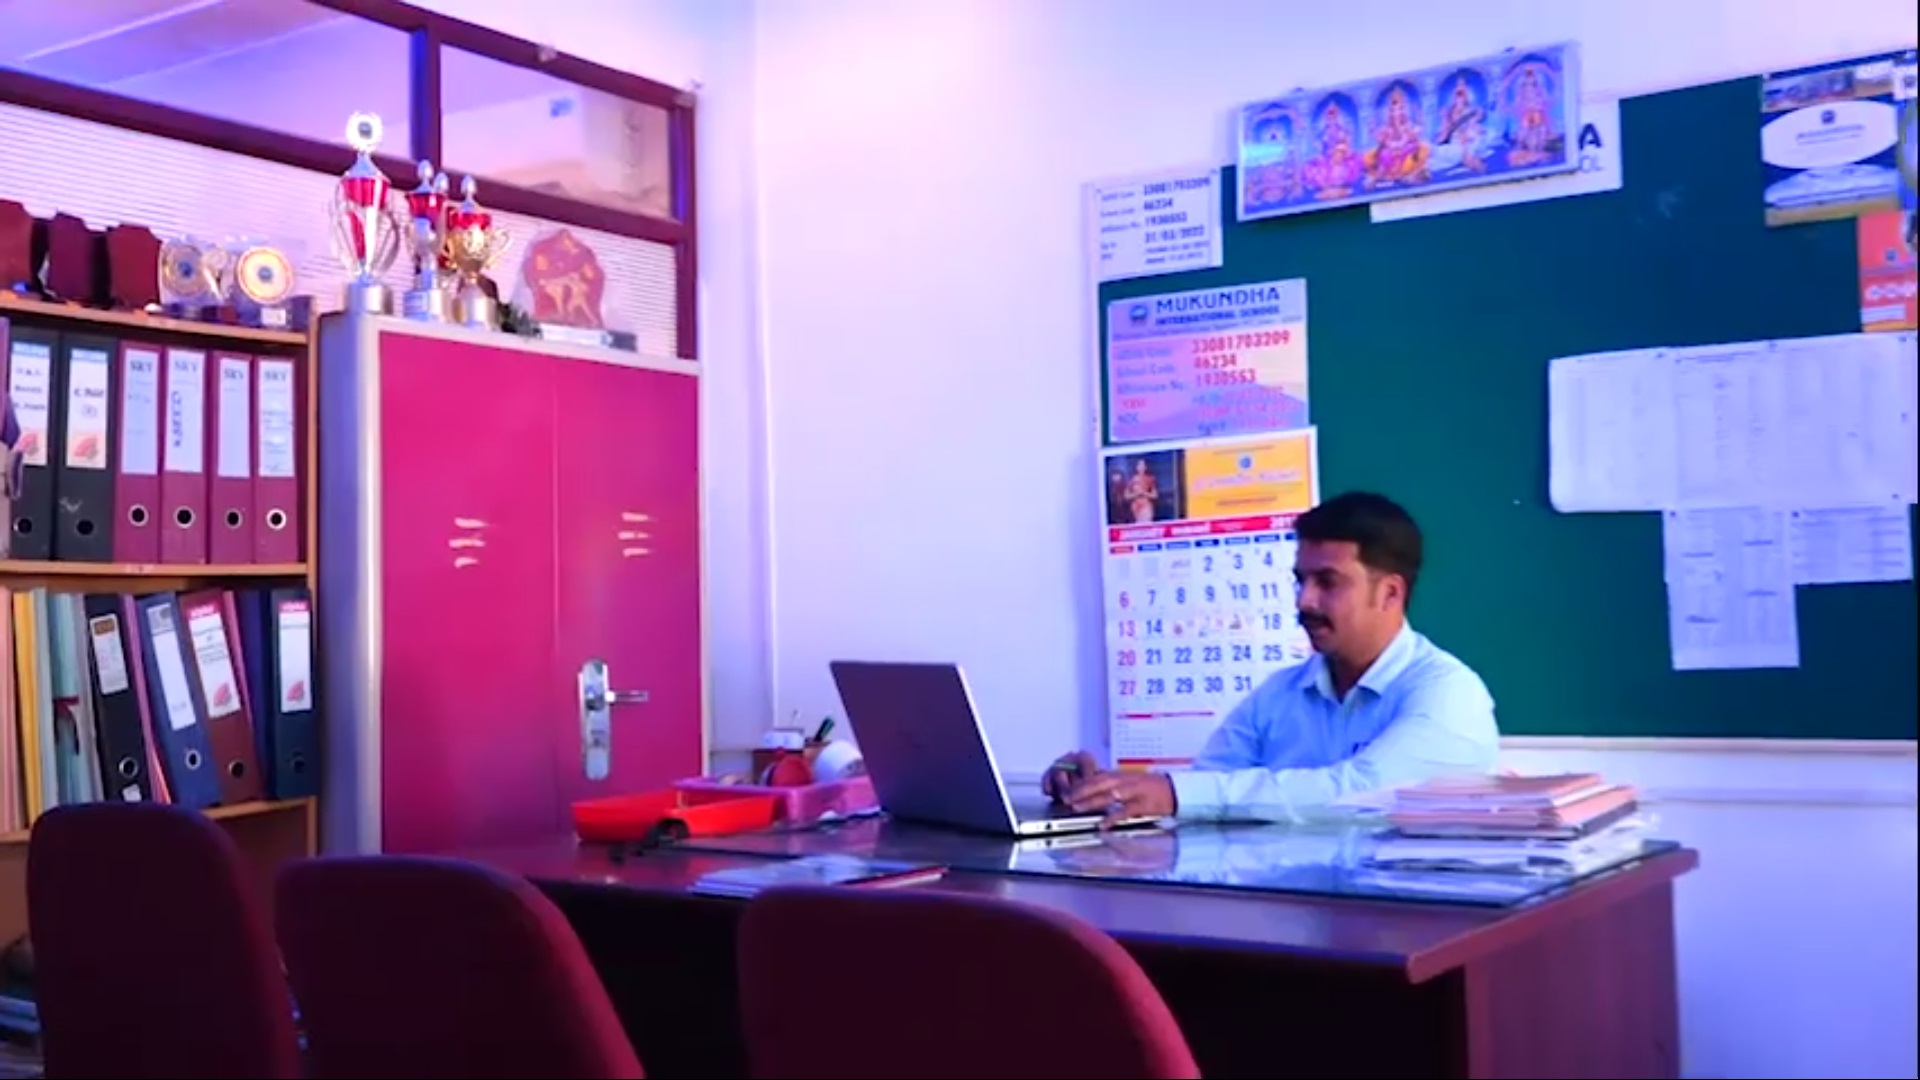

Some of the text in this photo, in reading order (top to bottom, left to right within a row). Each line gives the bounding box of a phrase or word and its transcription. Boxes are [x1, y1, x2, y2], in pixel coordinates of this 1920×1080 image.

[1156, 287, 1281, 314] MUKUNDHA
[1156, 305, 1281, 326] INTERNATIONAL SCHOOL
[1192, 330, 1291, 354] 33081703209
[1194, 353, 1238, 370] 46234
[1196, 368, 1258, 388] 1930553
[1203, 555, 1213, 572] 2
[1233, 553, 1244, 570] 3
[1262, 551, 1273, 568] 4
[1119, 583, 1278, 608] 6 7 8 9 10 11
[1118, 613, 1282, 637] 13 14 18
[1117, 645, 1283, 667] 20 21 22 23 24 25
[1118, 675, 1252, 696] 27 28 29 30 31
